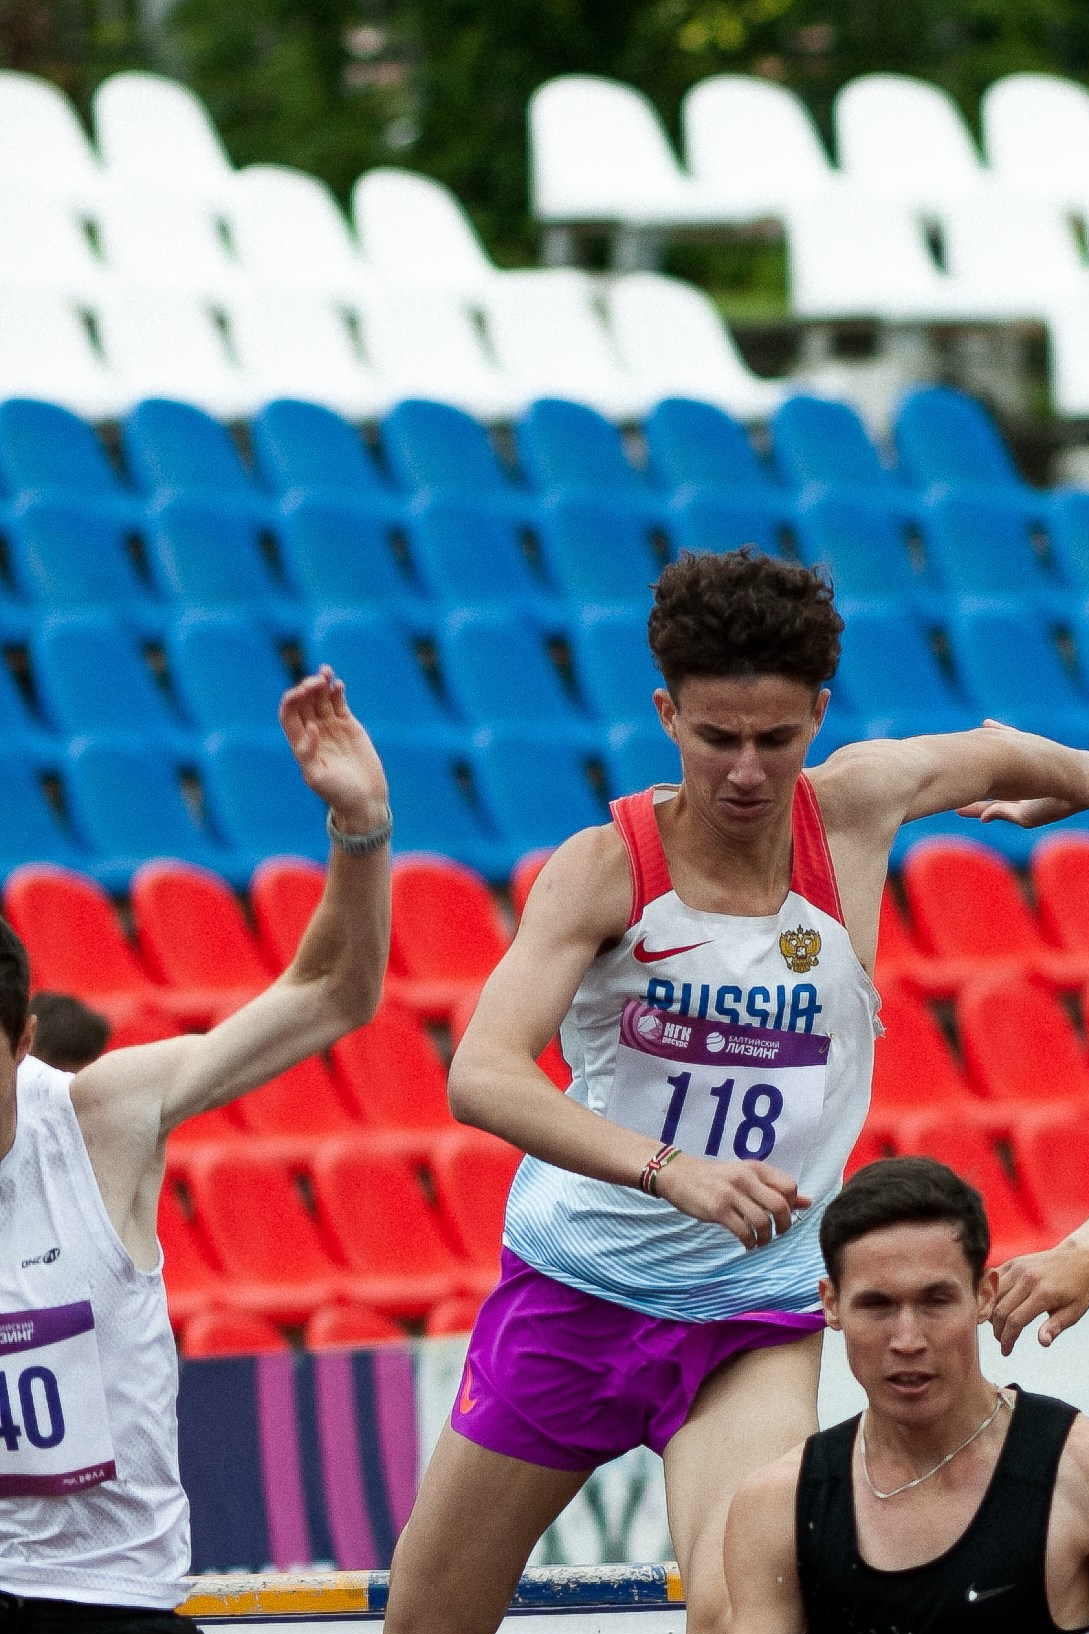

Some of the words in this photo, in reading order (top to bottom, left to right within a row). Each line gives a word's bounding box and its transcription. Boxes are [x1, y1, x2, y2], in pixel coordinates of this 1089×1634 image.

[645, 977, 823, 1034] RUSSIA
[663, 1022, 692, 1042] НГК
[728, 1035, 780, 1049] БАЛТИЙСКИЙ
[725, 1043, 780, 1060] ЛИЗИНГ
[660, 1071, 784, 1162] 118
